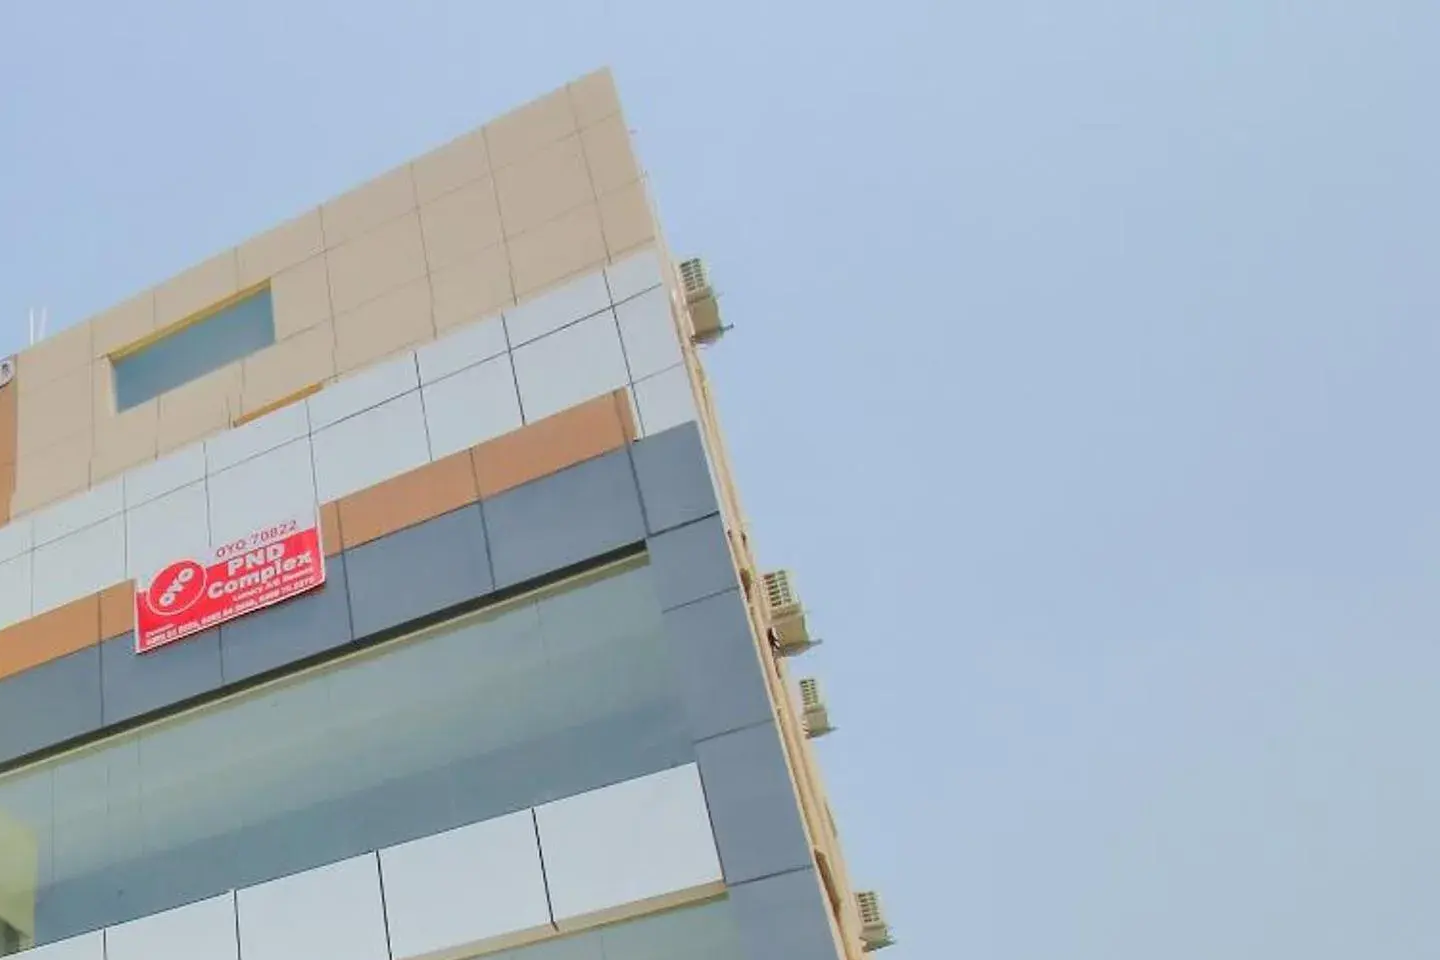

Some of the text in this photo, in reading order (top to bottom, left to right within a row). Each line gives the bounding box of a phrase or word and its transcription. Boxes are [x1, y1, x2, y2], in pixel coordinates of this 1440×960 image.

[215, 541, 246, 558] OYO
[227, 543, 285, 576] PND
[207, 550, 312, 599] Complex
